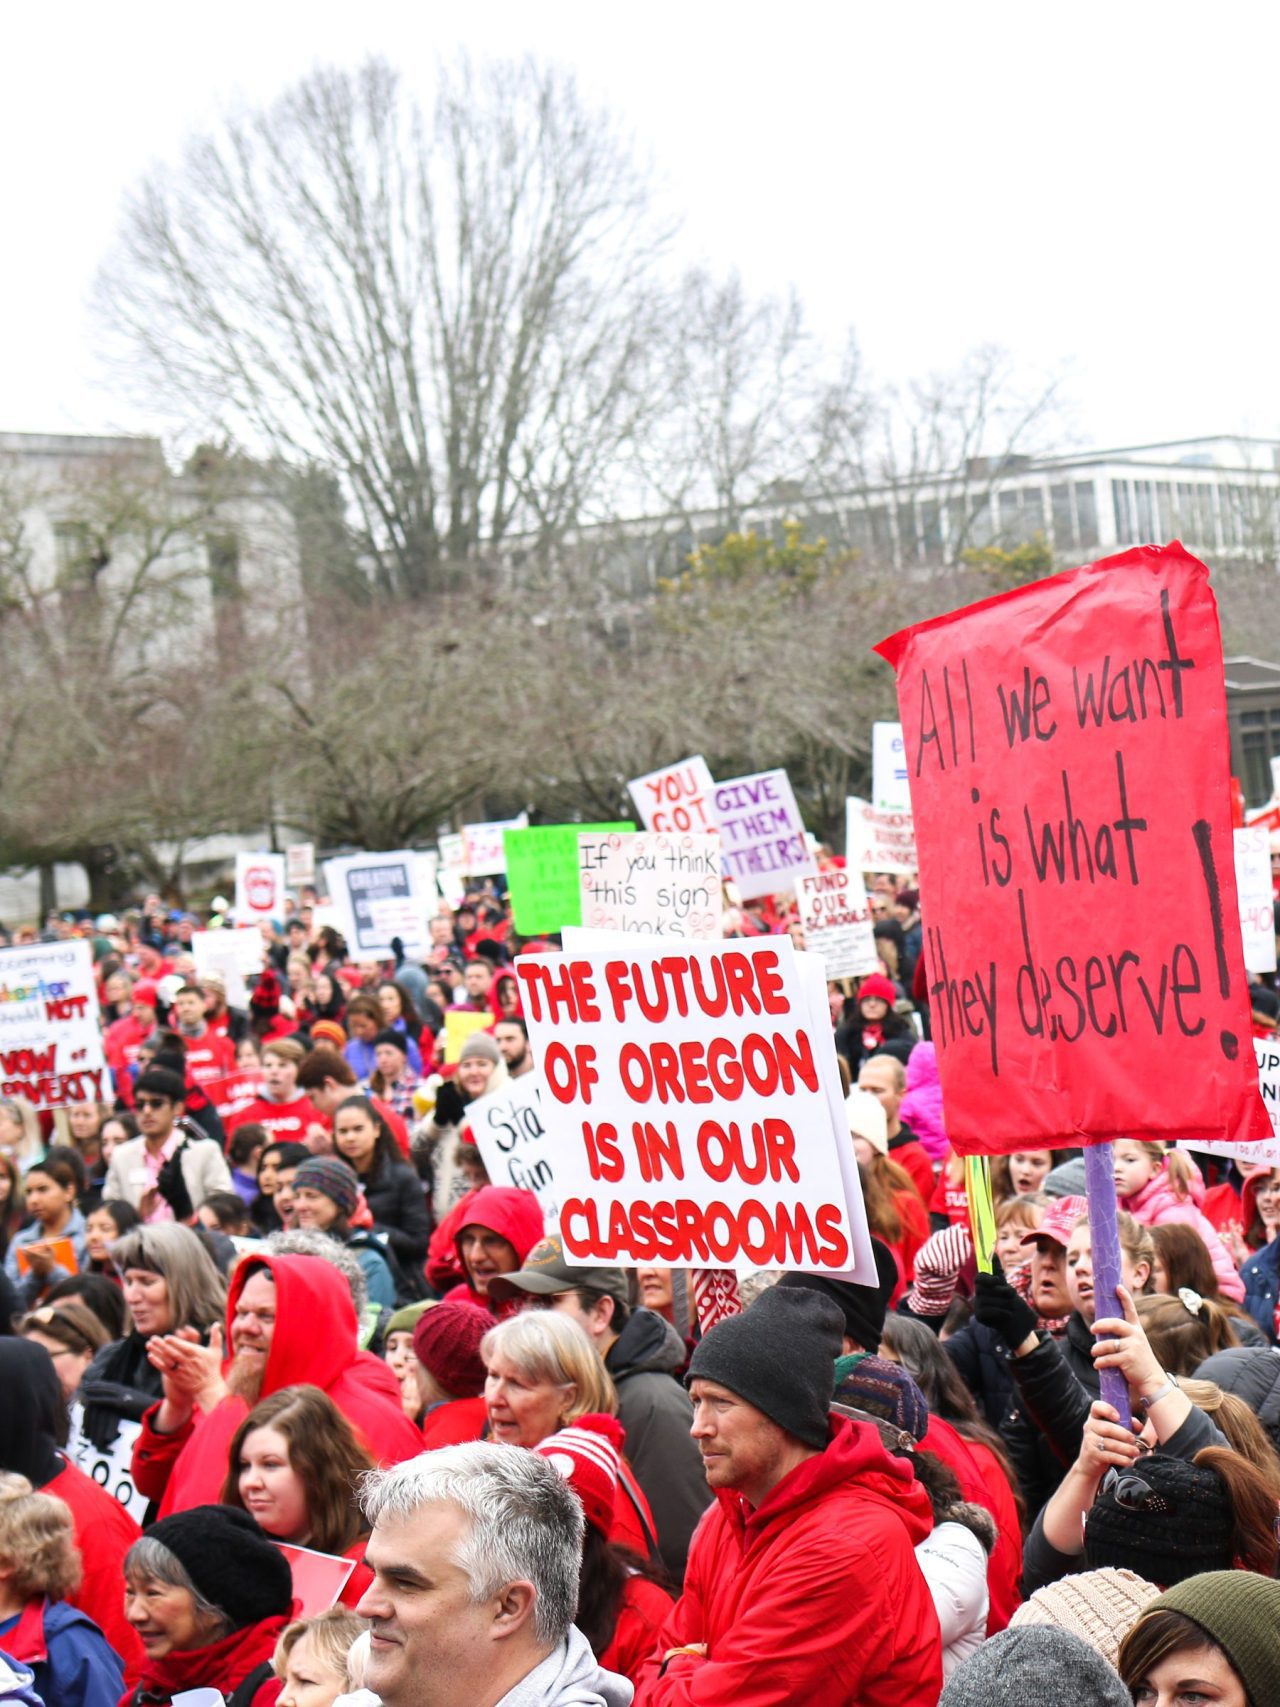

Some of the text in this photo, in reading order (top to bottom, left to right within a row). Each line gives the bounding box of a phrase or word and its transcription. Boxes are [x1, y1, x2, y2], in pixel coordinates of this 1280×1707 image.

[916, 589, 1194, 778] All we want
[646, 768, 697, 804] YOU
[715, 777, 779, 811] GIVE
[653, 798, 706, 832] GOT
[722, 808, 792, 840] THEM
[971, 750, 1147, 888] is what
[580, 843, 718, 883] If you think
[588, 880, 709, 919] this sign
[803, 873, 848, 894] FUND
[806, 909, 871, 931] SCHOOLS
[813, 894, 848, 914] OUR
[927, 819, 1239, 1076] they deserve!
[517, 961, 600, 1024] THE
[605, 951, 790, 1023] FUTURE
[45, 996, 88, 1020] NOT
[544, 1029, 819, 1105] OF OREGON
[582, 1119, 800, 1185] IS IN OUR
[560, 1198, 849, 1267] CLASSROOMS
